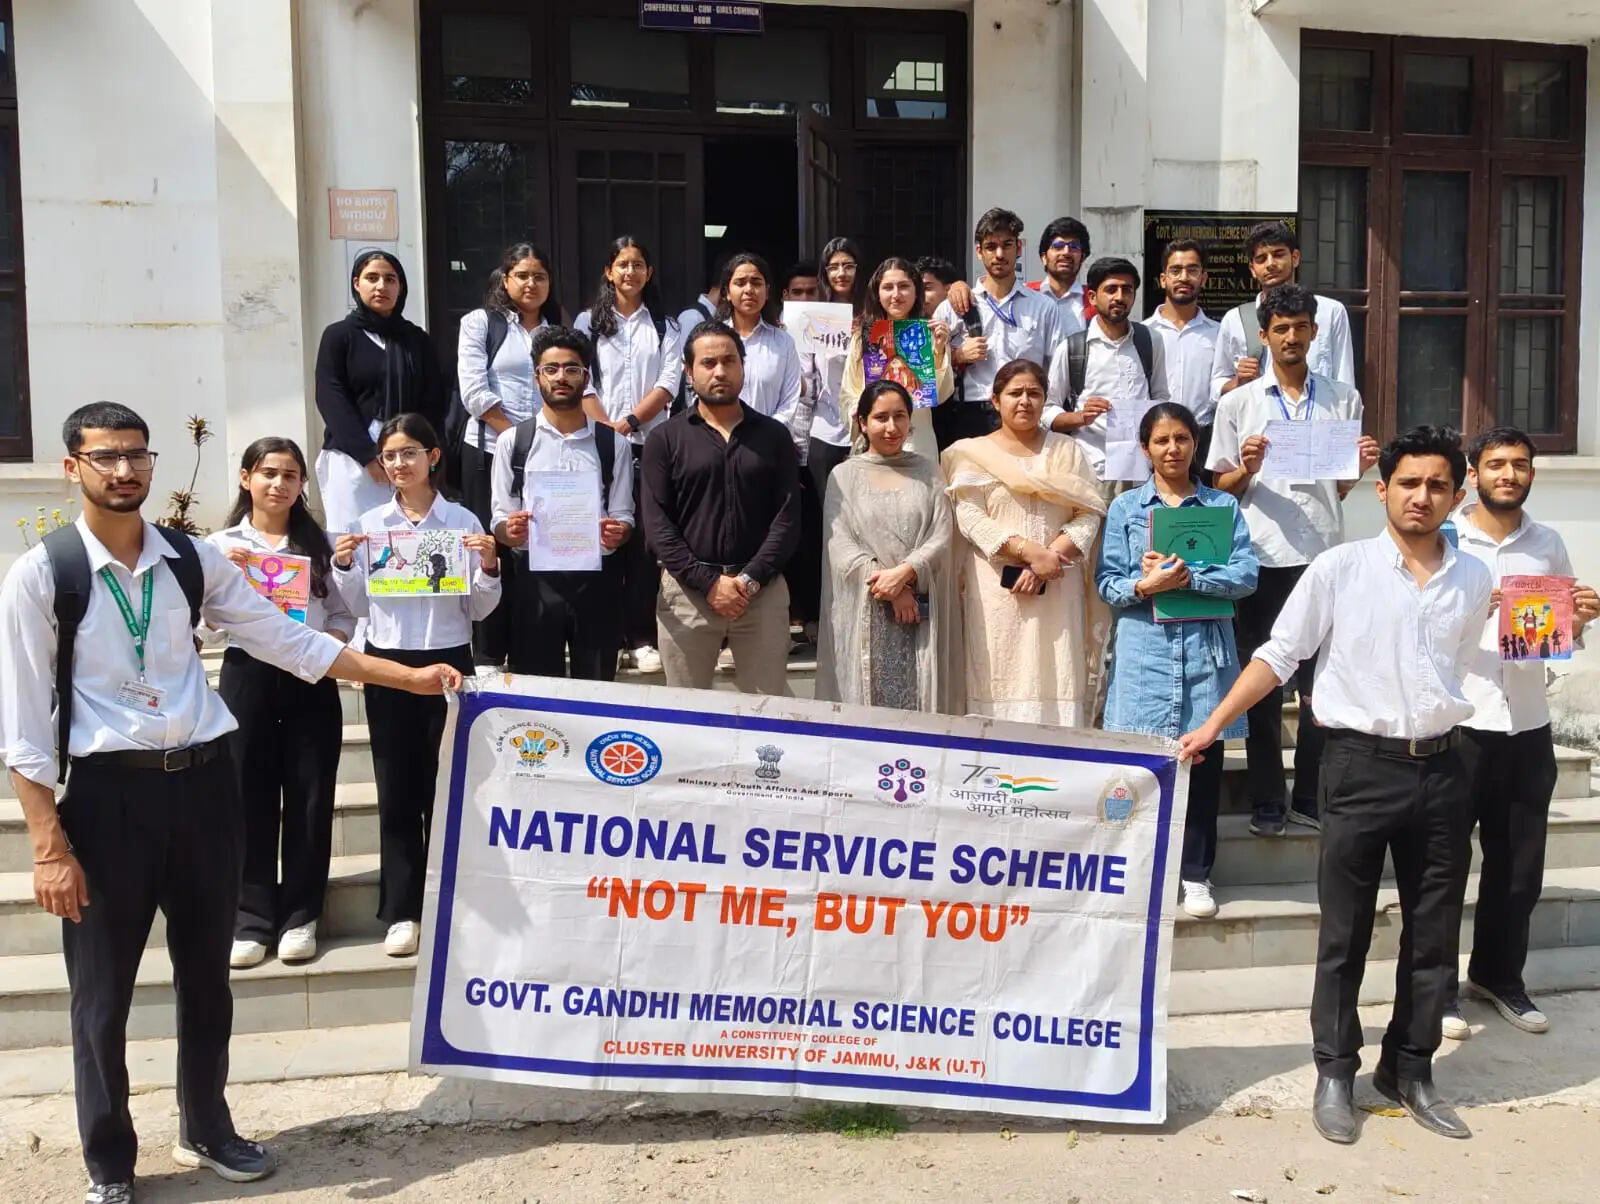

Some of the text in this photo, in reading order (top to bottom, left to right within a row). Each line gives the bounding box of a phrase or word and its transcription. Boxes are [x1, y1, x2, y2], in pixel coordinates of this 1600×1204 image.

[644, 3, 680, 12] CONFERENCE
[680, 4, 694, 12] HALL
[716, 6, 732, 14] GIRLS
[734, 6, 759, 15] COMMON
[694, 16, 711, 24] ROOM
[336, 197, 387, 206] NO ENTRY
[339, 209, 386, 220] WITHOUT
[1218, 226, 1240, 239] SCIENCE
[534, 722, 564, 738] COLLEGE
[590, 748, 606, 778] NATIONAL
[606, 776, 642, 784] SERVICE
[678, 778, 718, 787] Ministry
[734, 782, 762, 790] Youth
[766, 784, 797, 793] Affairs
[822, 790, 853, 798] Sports
[726, 790, 772, 799] Government
[967, 803, 1071, 820] अमृत महोत्सव
[488, 806, 1127, 895] NATIONAL SERVICE SCHEME
[586, 875, 1030, 942] “NOT ME, BUT YOU”
[465, 977, 1121, 1048] GOVT. GANDHI MEMORIAL SCIENCE COLLEGE
[720, 1030, 878, 1047] A CONSTITUENT COLLEGE OF
[602, 1040, 986, 1078] CLUSTER UNIVERSITY OF JAMMU, J&K (U.T)
